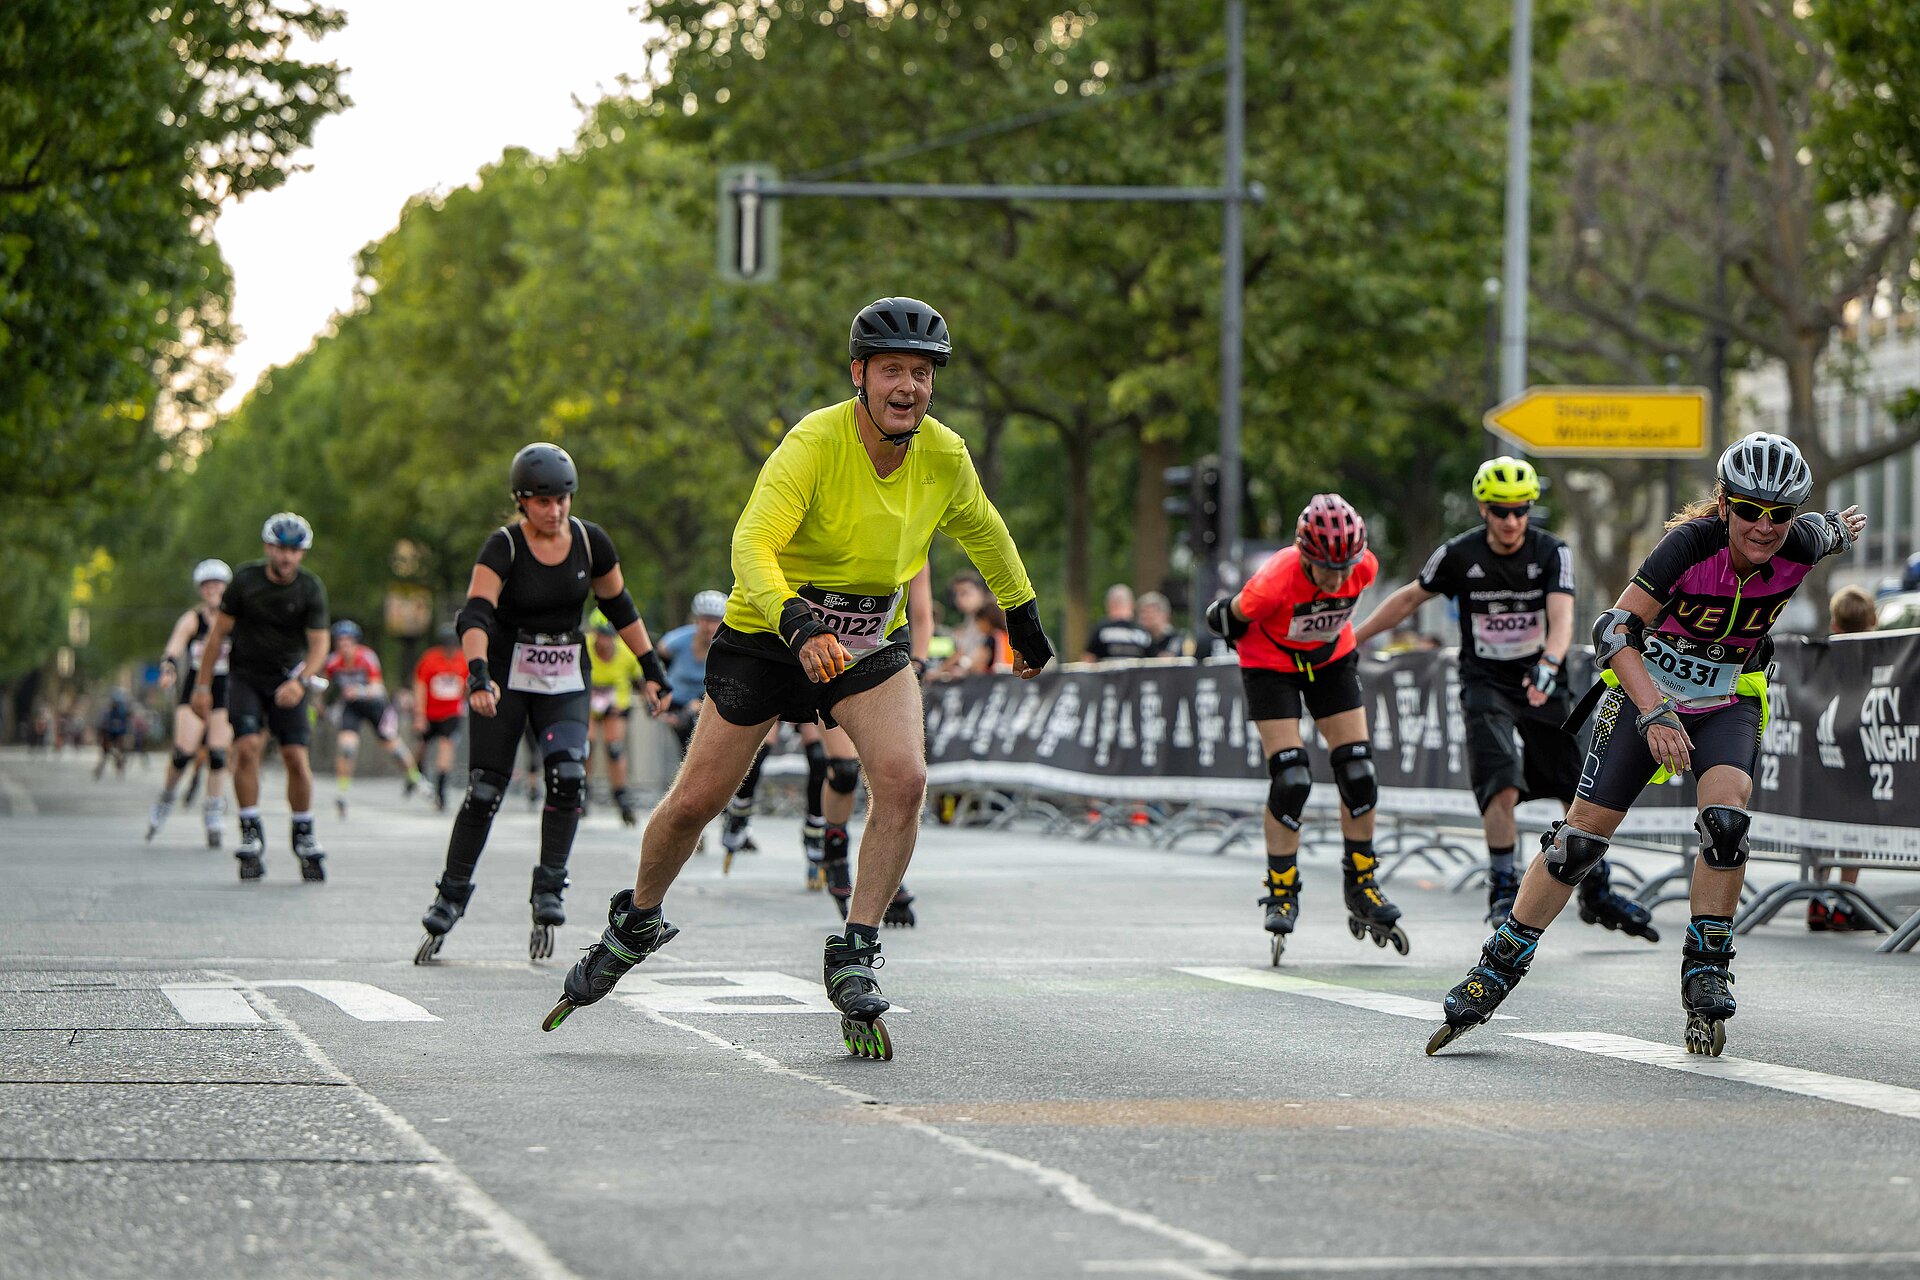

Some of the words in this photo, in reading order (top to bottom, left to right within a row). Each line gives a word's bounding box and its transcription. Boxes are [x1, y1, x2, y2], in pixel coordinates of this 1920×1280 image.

[1486, 616, 1538, 631] 20024
[526, 648, 575, 664] 20096
[1642, 641, 1721, 687] 20331
[1661, 675, 1686, 693] Sabine
[1861, 686, 1900, 724] CITY
[1859, 725, 1919, 763] NIGHT
[1760, 753, 1780, 791] 22
[1869, 763, 1894, 800] 22
